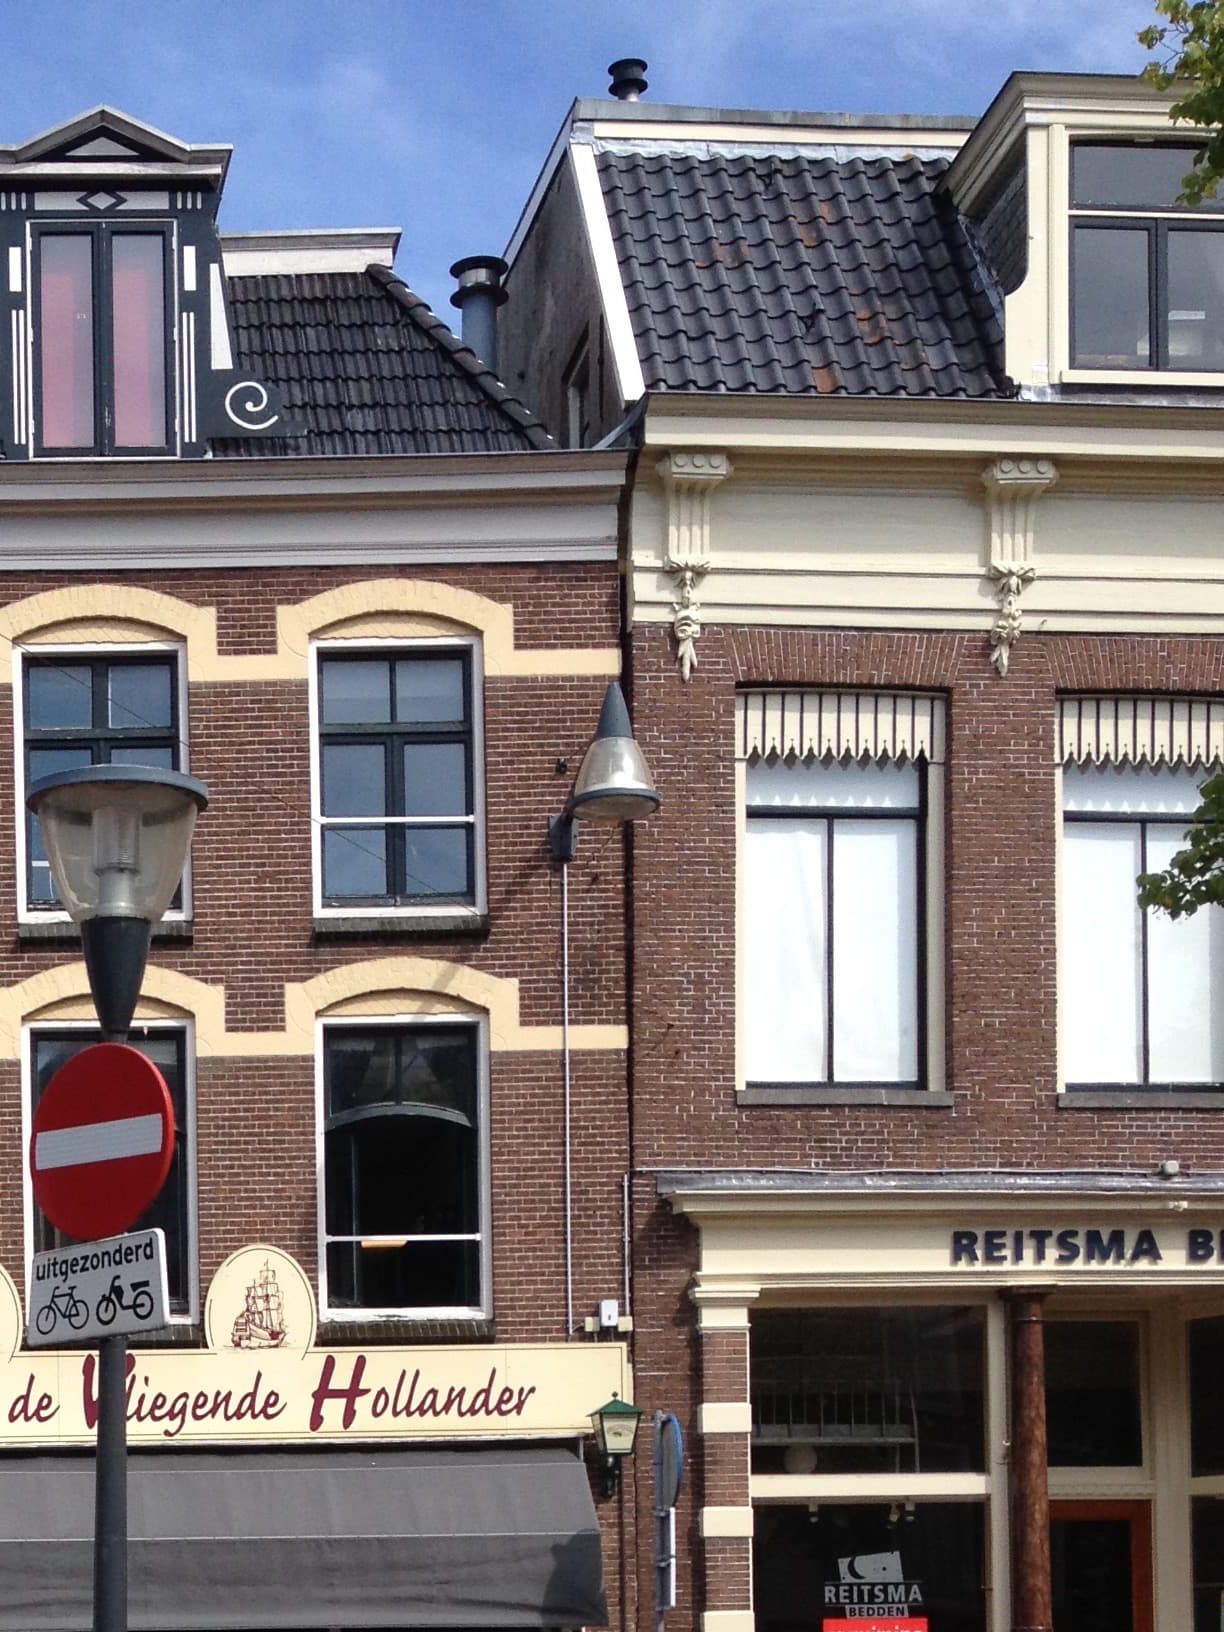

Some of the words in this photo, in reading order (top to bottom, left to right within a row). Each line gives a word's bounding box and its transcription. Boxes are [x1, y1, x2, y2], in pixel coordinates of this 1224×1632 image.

[36, 1238, 154, 1282] uitgezonderd
[952, 1229, 1163, 1262] REITSMA
[1188, 1229, 1224, 1262] B
[8, 1373, 60, 1424] de
[310, 1354, 536, 1432] Hollander
[824, 1584, 923, 1603] REITSMA
[849, 1606, 905, 1617] BEDDEN
